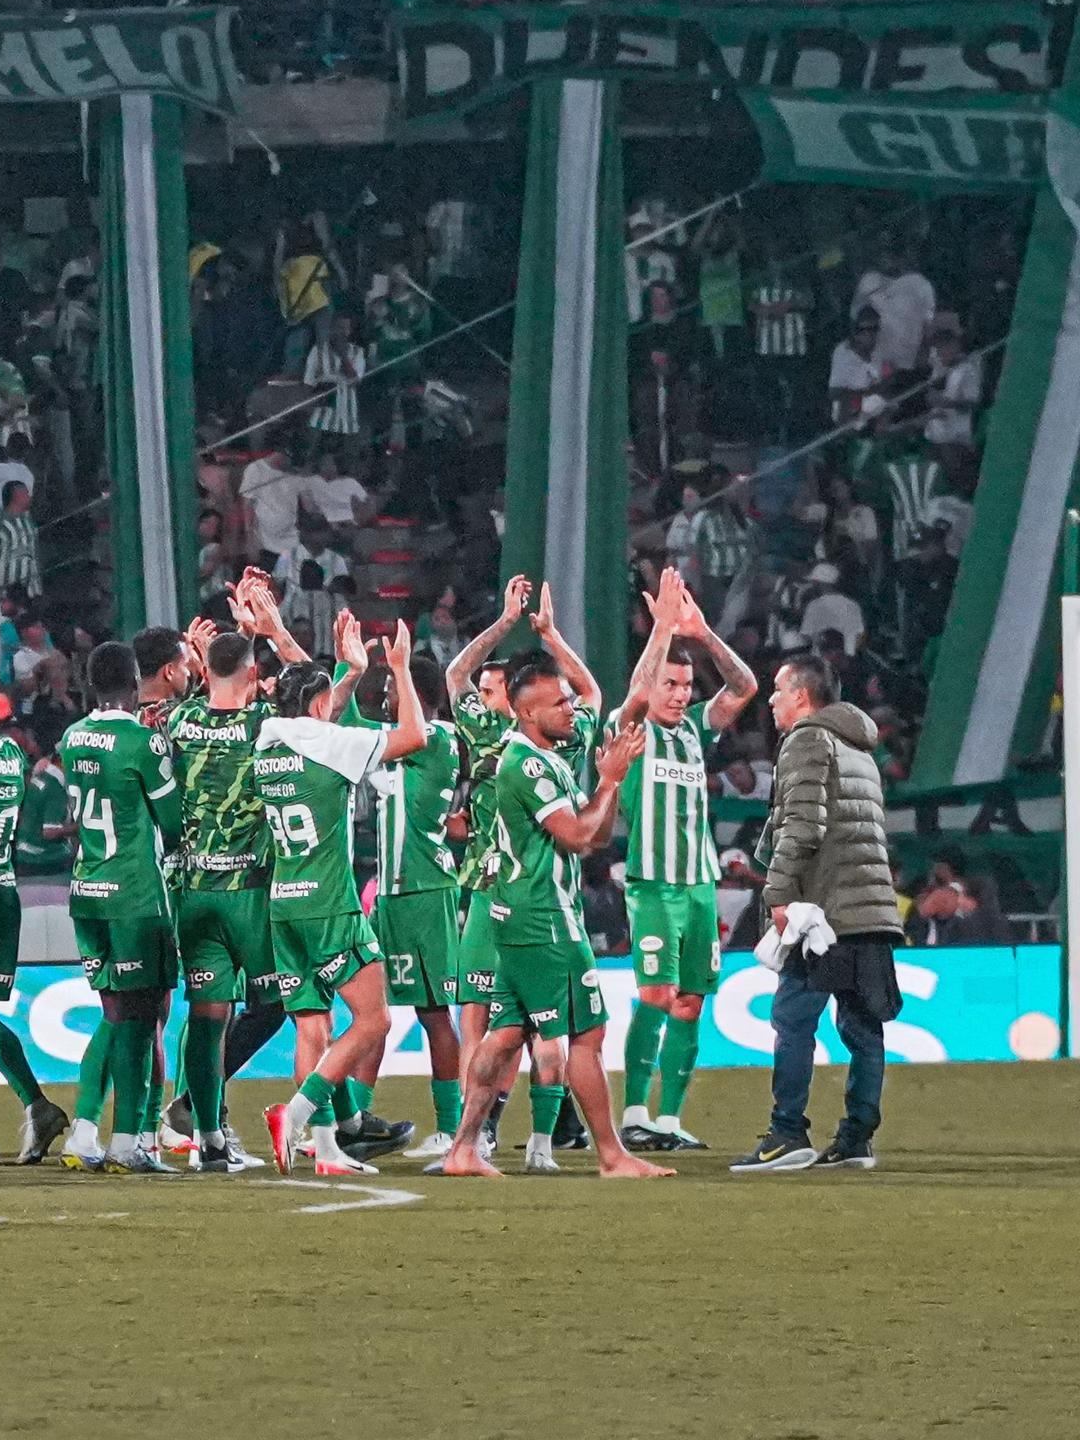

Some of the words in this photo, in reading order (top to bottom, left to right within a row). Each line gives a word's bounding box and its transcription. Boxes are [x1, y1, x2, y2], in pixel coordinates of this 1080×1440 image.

[67, 731, 116, 751] POSTOBON
[178, 720, 248, 742] POSTOBON
[254, 755, 304, 775] POSTOBON
[389, 954, 415, 985] 32
